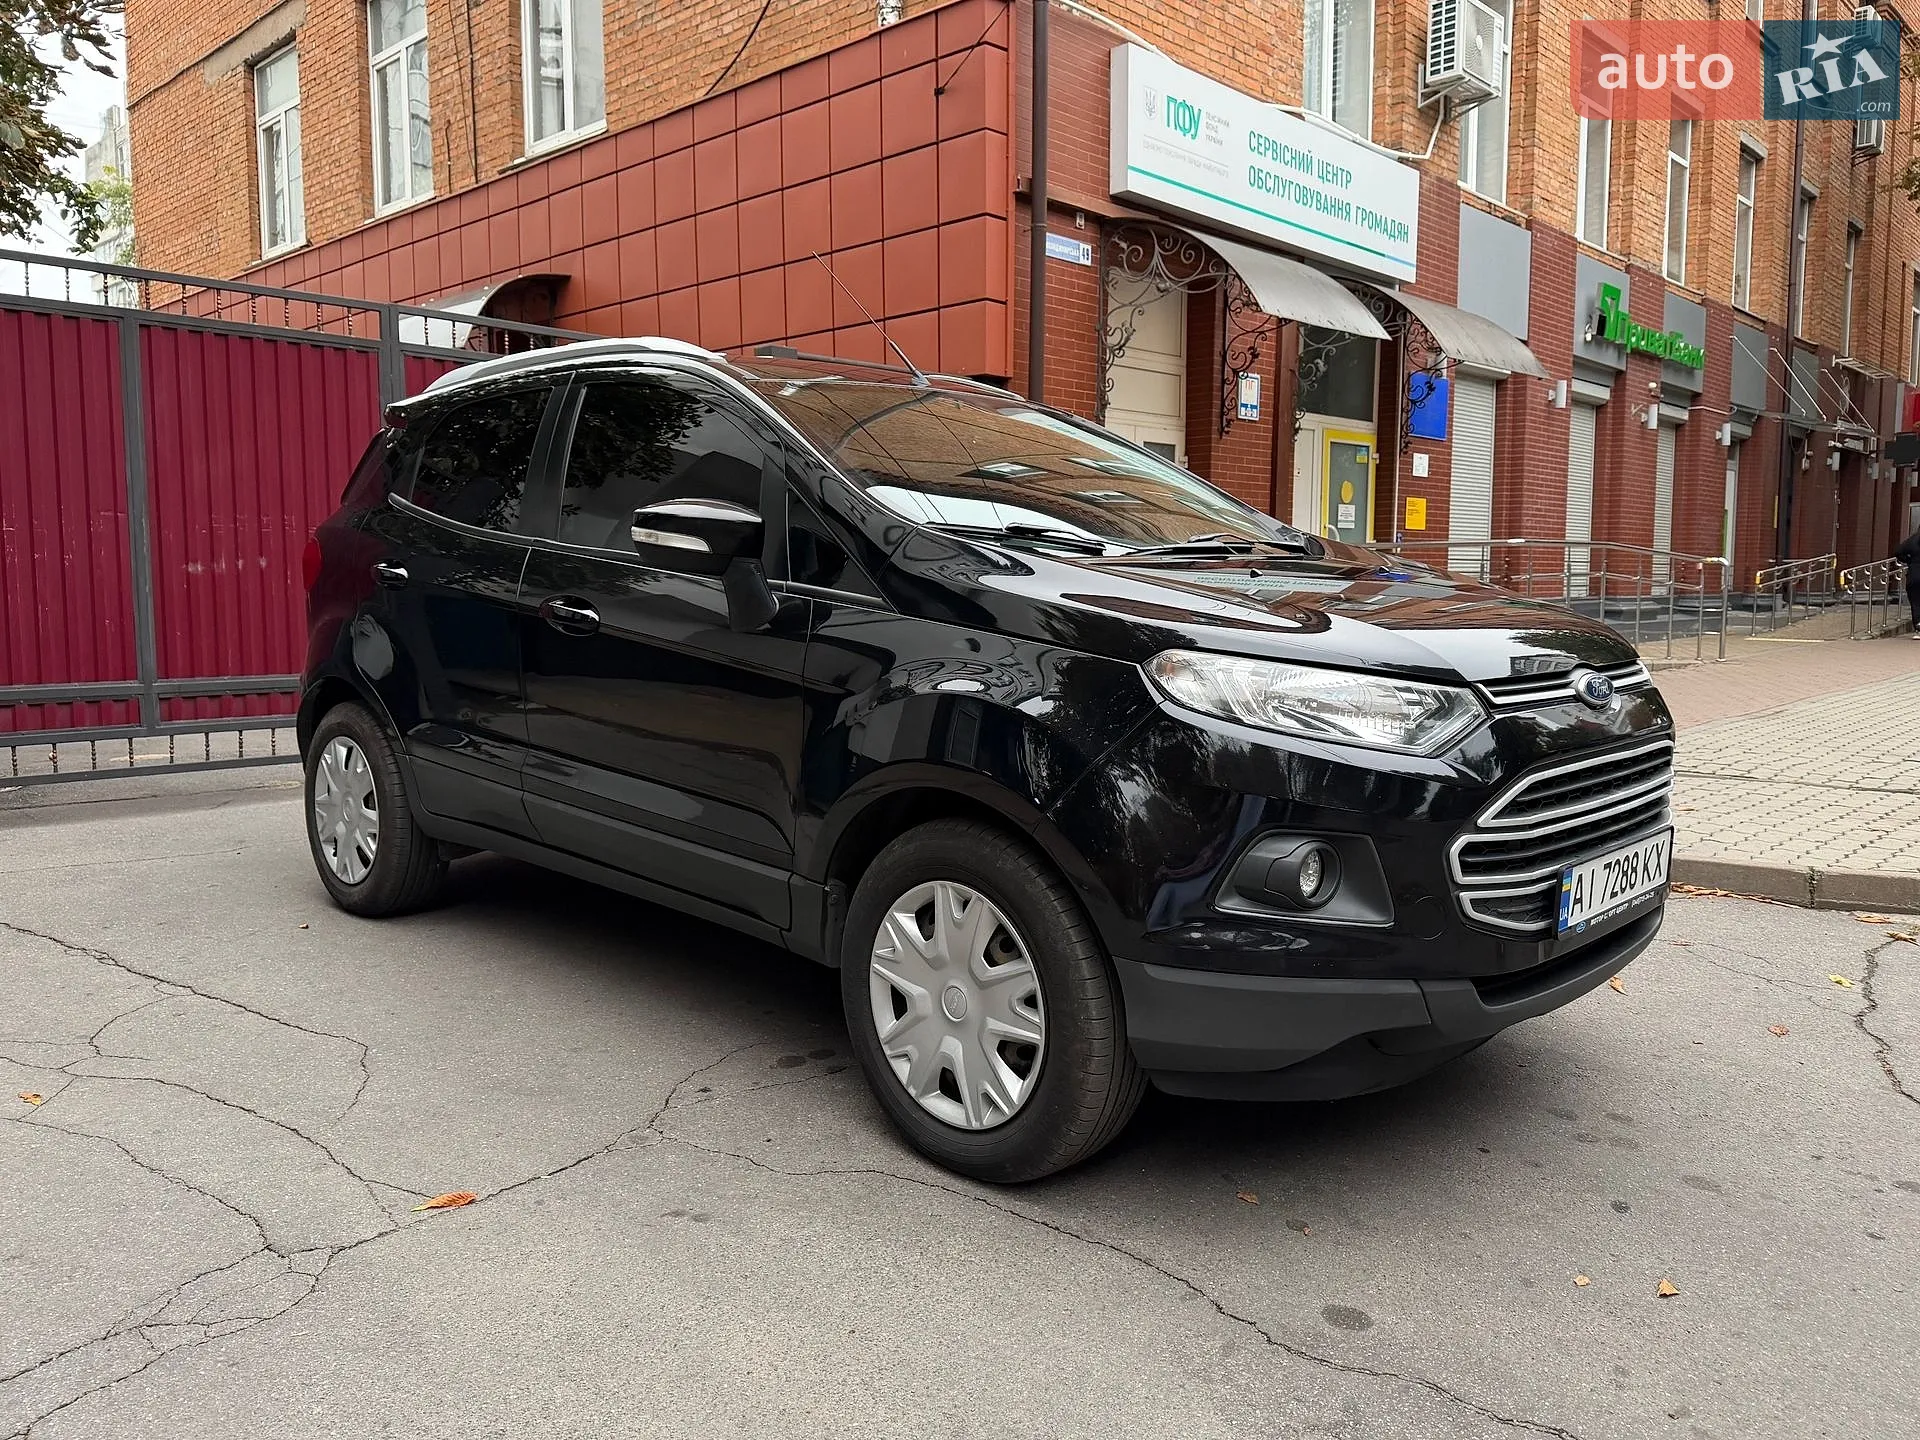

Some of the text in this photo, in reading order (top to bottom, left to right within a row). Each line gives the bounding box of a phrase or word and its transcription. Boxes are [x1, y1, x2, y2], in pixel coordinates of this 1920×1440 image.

[1166, 95, 1202, 140] ПФУ
[1248, 130, 1313, 176] СЕРВІСНИЙ
[1317, 158, 1352, 190] ЦЕНТР
[1248, 165, 1409, 243] ОБСЛУГОВУВАННЯ ГРОМАДЯН
[1591, 678, 1610, 697] Ford
[1570, 840, 1666, 918] AI 7288 KX
[1560, 906, 1569, 921] UA
